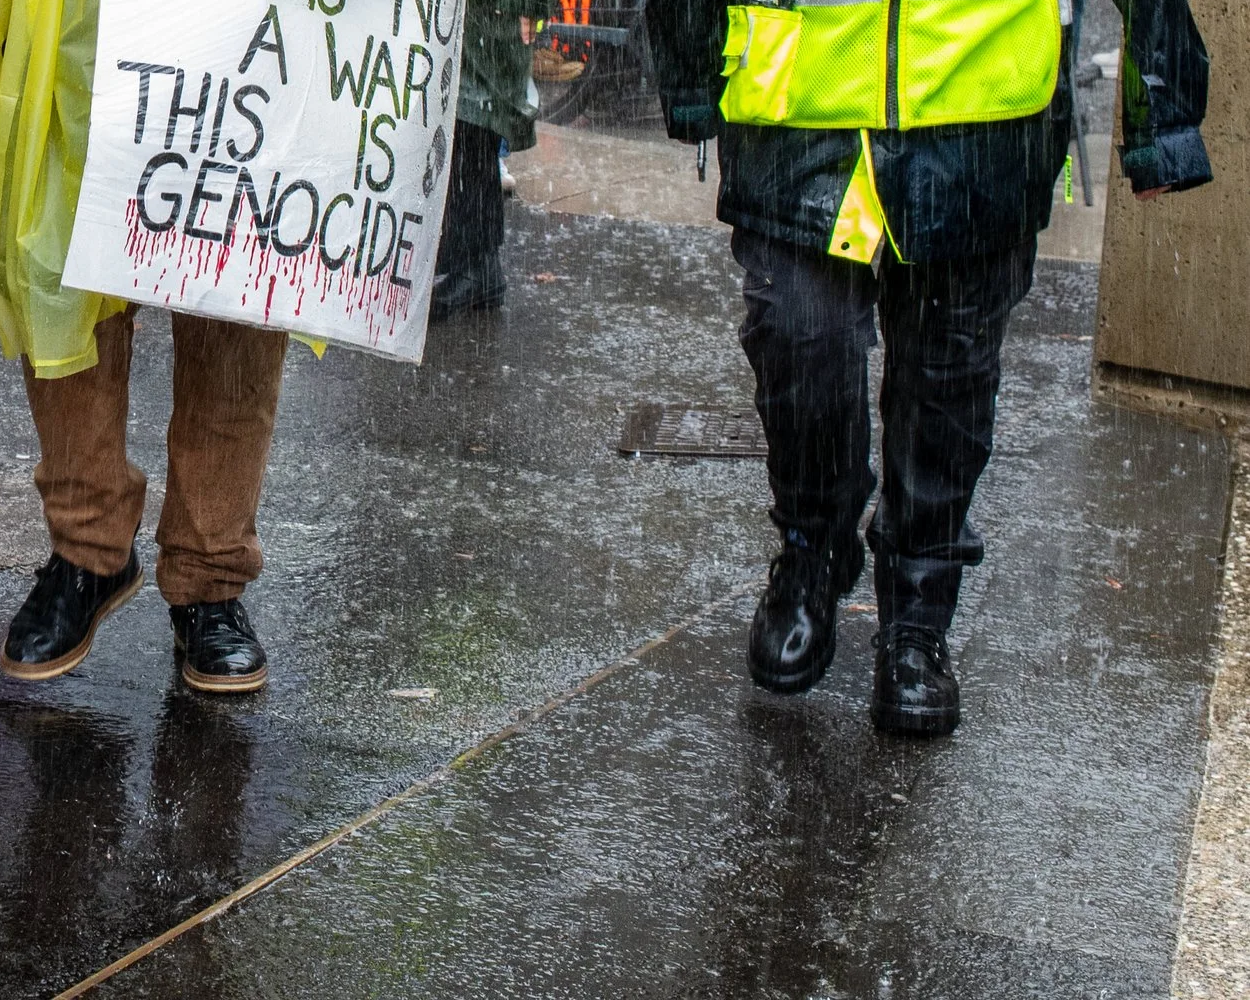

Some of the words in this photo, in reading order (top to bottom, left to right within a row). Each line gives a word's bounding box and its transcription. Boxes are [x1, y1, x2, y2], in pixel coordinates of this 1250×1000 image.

[238, 4, 287, 85] A
[117, 59, 270, 162] THIS
[353, 110, 396, 192] IS
[136, 152, 424, 289] GENOCIDE
